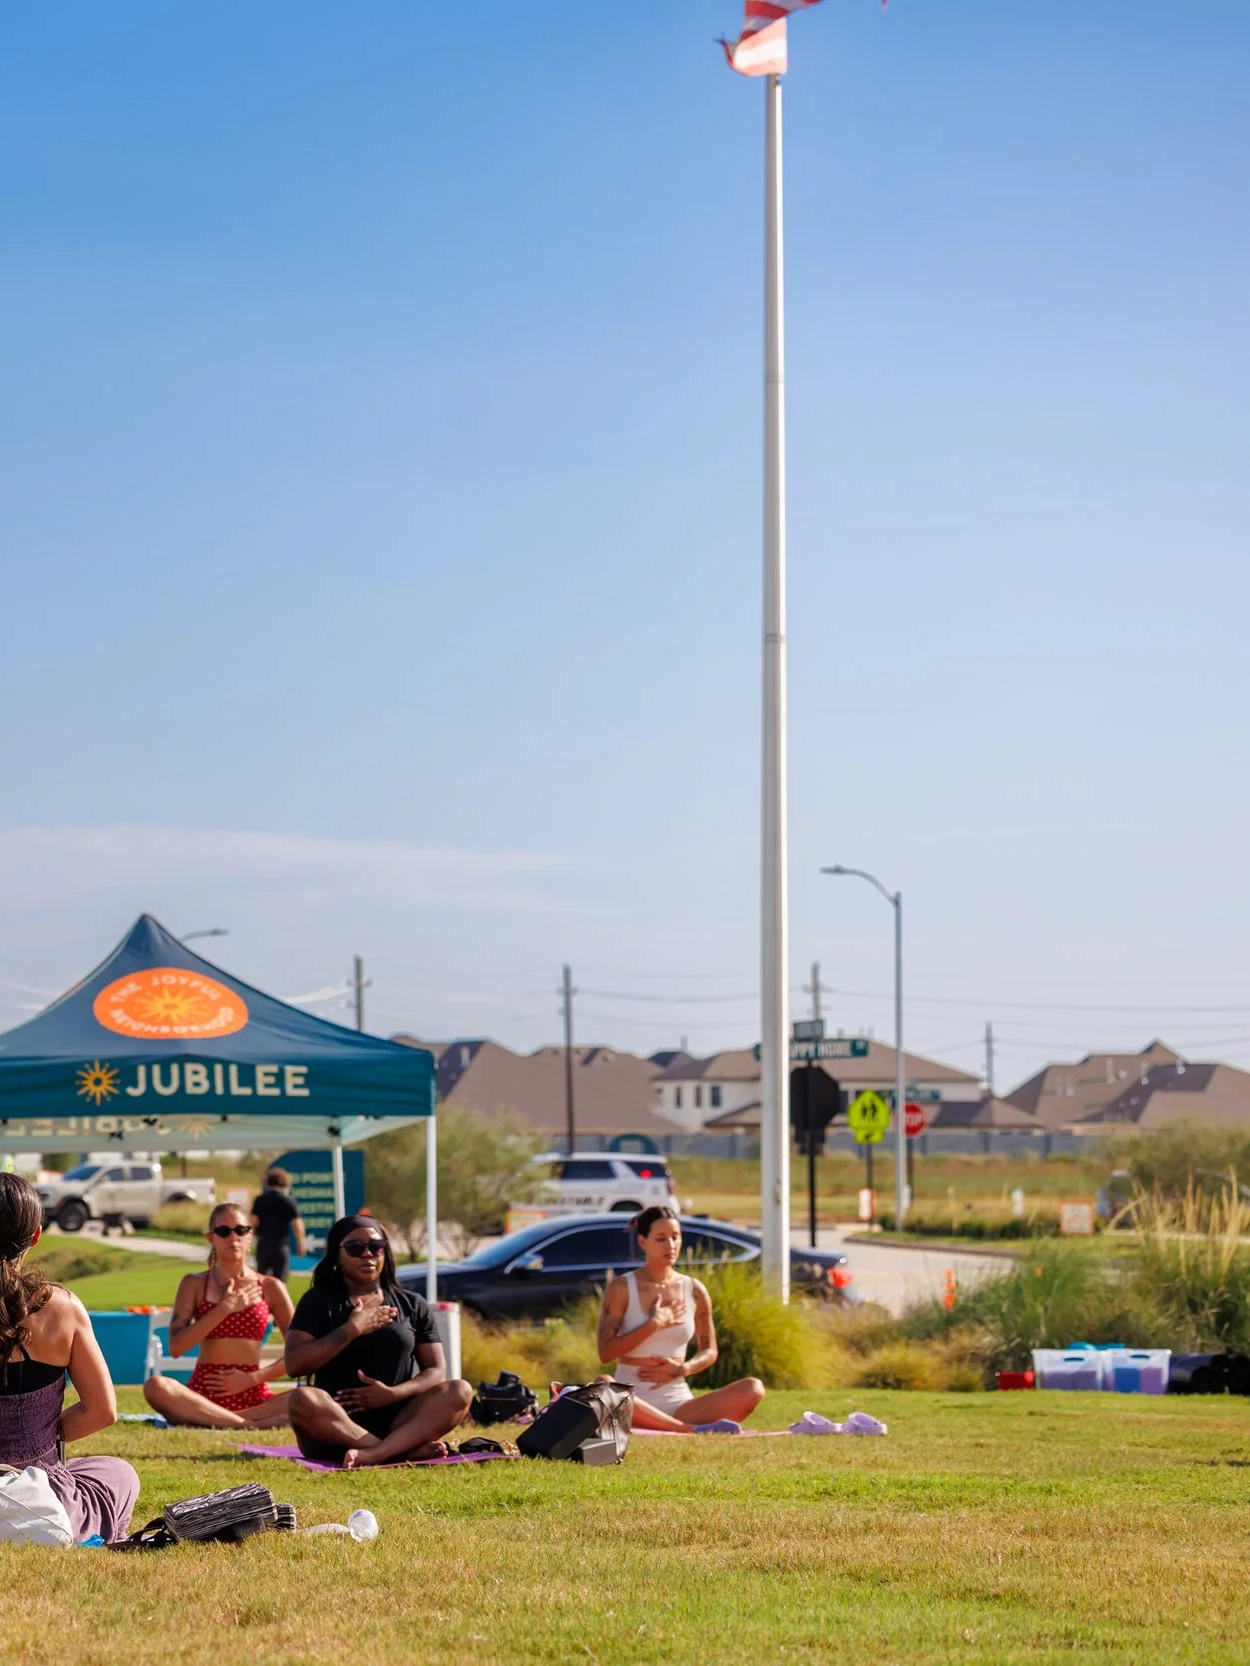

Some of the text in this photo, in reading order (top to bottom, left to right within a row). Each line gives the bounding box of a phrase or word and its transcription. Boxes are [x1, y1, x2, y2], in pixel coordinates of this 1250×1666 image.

[110, 974, 222, 1003] THE JOYFUL
[111, 1005, 234, 1034] NEIGHBORHOOD
[789, 1042, 815, 1057] PPY
[125, 1062, 310, 1097] JUBILEE
[905, 1112, 923, 1127] OP
[302, 1171, 346, 1184] POINT
